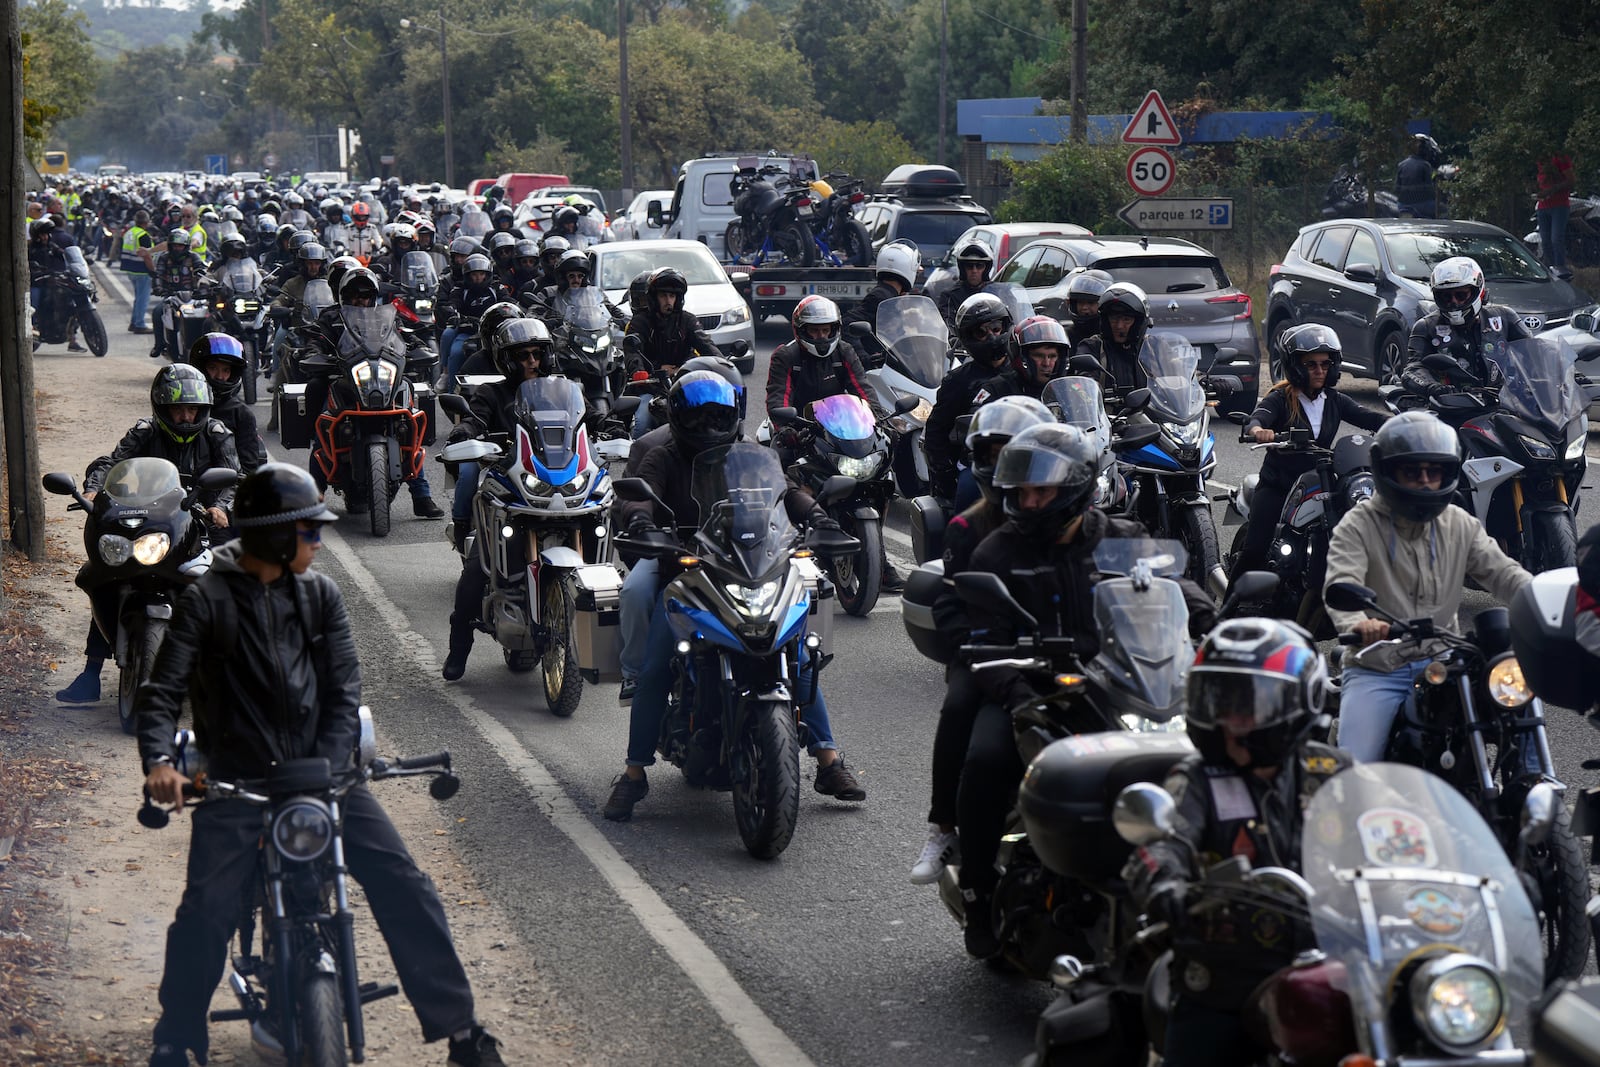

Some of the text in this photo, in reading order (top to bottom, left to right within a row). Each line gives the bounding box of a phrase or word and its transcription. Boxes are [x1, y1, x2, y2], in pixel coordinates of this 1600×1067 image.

[1135, 162, 1167, 181] 50
[1139, 206, 1225, 224] parque 12 P
